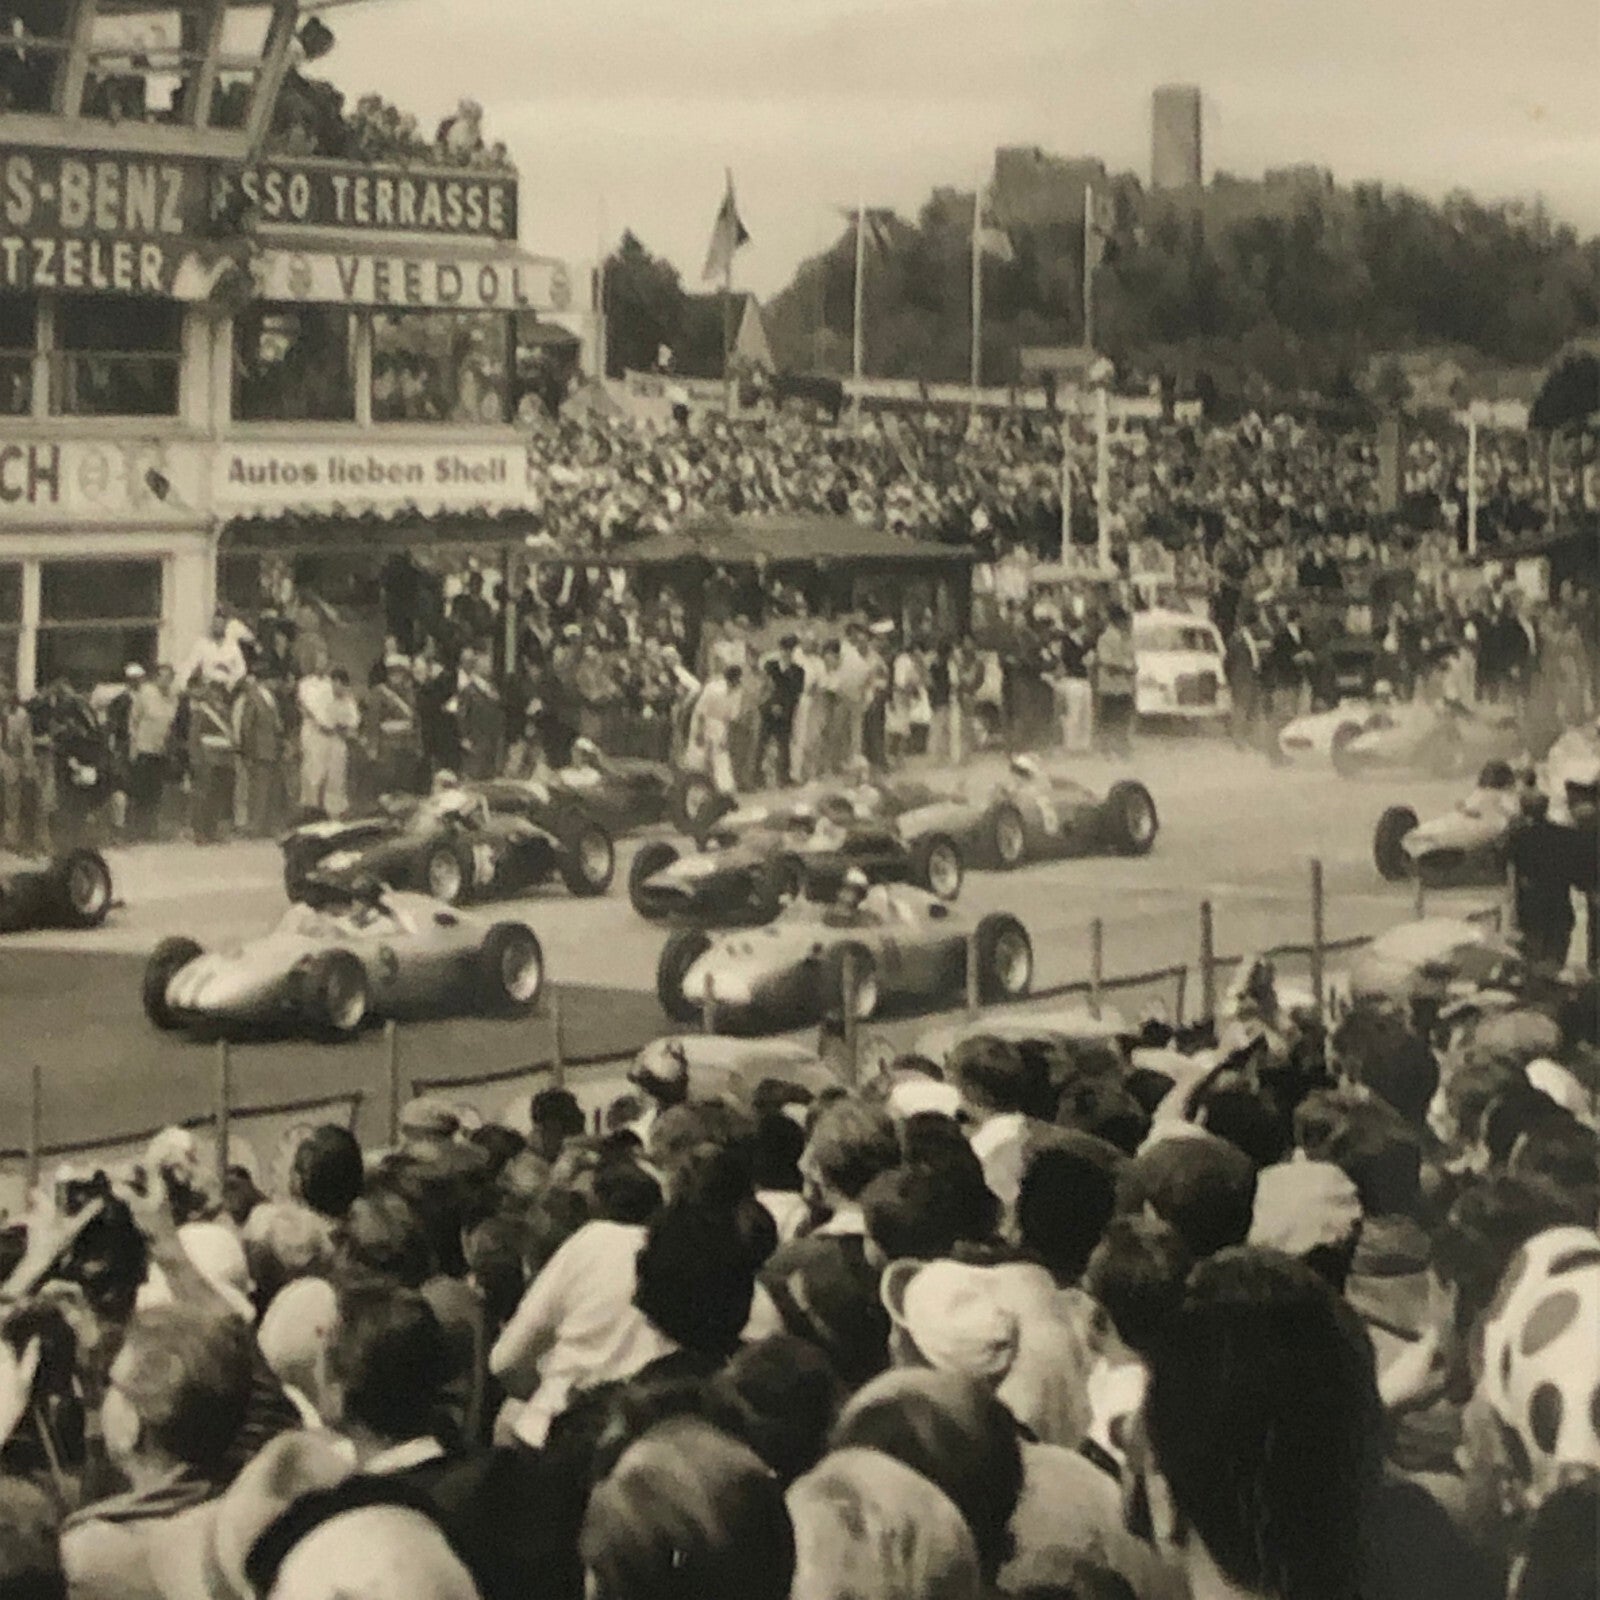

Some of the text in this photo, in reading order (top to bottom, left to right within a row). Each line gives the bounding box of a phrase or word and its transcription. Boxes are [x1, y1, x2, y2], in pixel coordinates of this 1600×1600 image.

[333, 176, 506, 231] TERRASSE
[1, 236, 164, 292] TZELER
[335, 257, 528, 306] VEEDOL
[0, 444, 61, 504] CH
[229, 455, 506, 486] Autos lieben Shell
